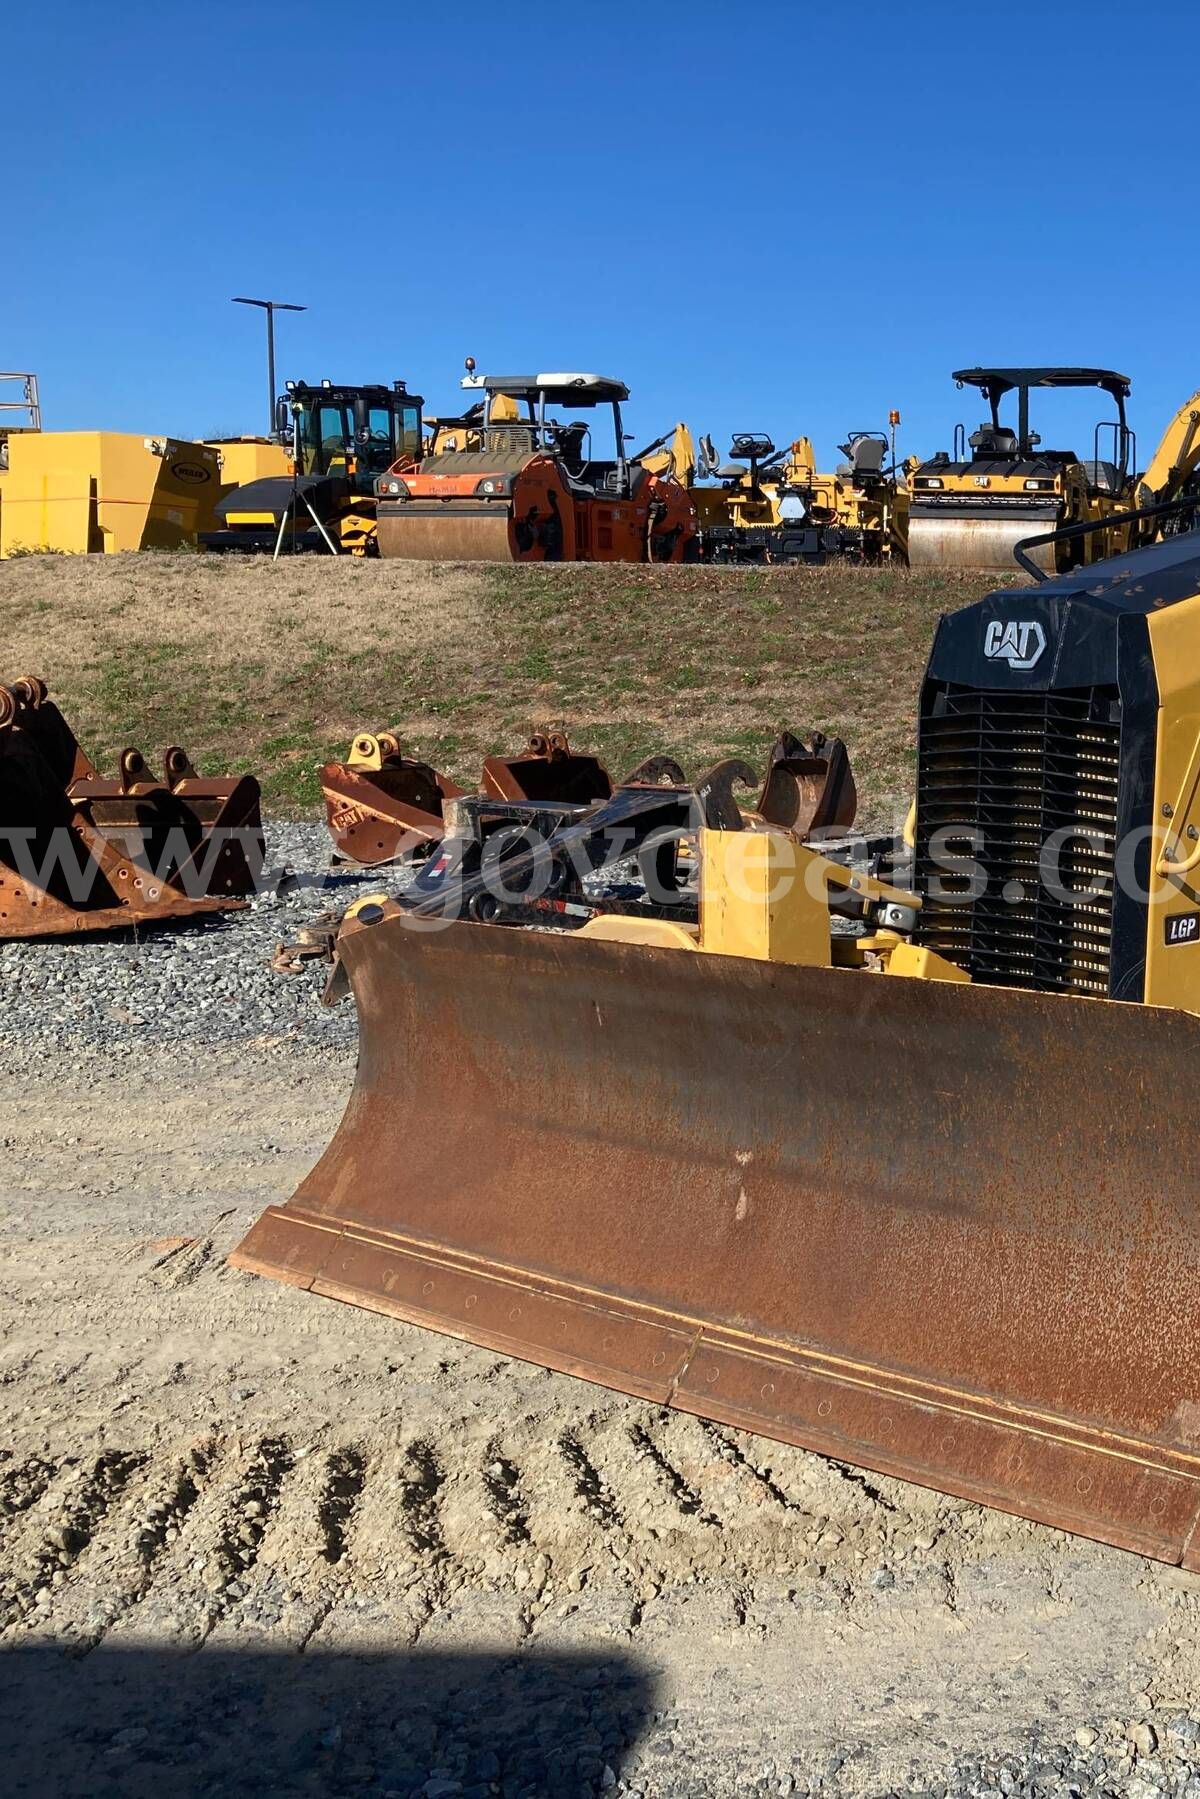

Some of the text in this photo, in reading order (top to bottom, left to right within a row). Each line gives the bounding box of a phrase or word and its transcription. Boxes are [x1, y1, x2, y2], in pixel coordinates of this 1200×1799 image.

[984, 620, 1035, 658] CAT
[335, 809, 359, 828] CAT
[1170, 918, 1197, 940] LGP
